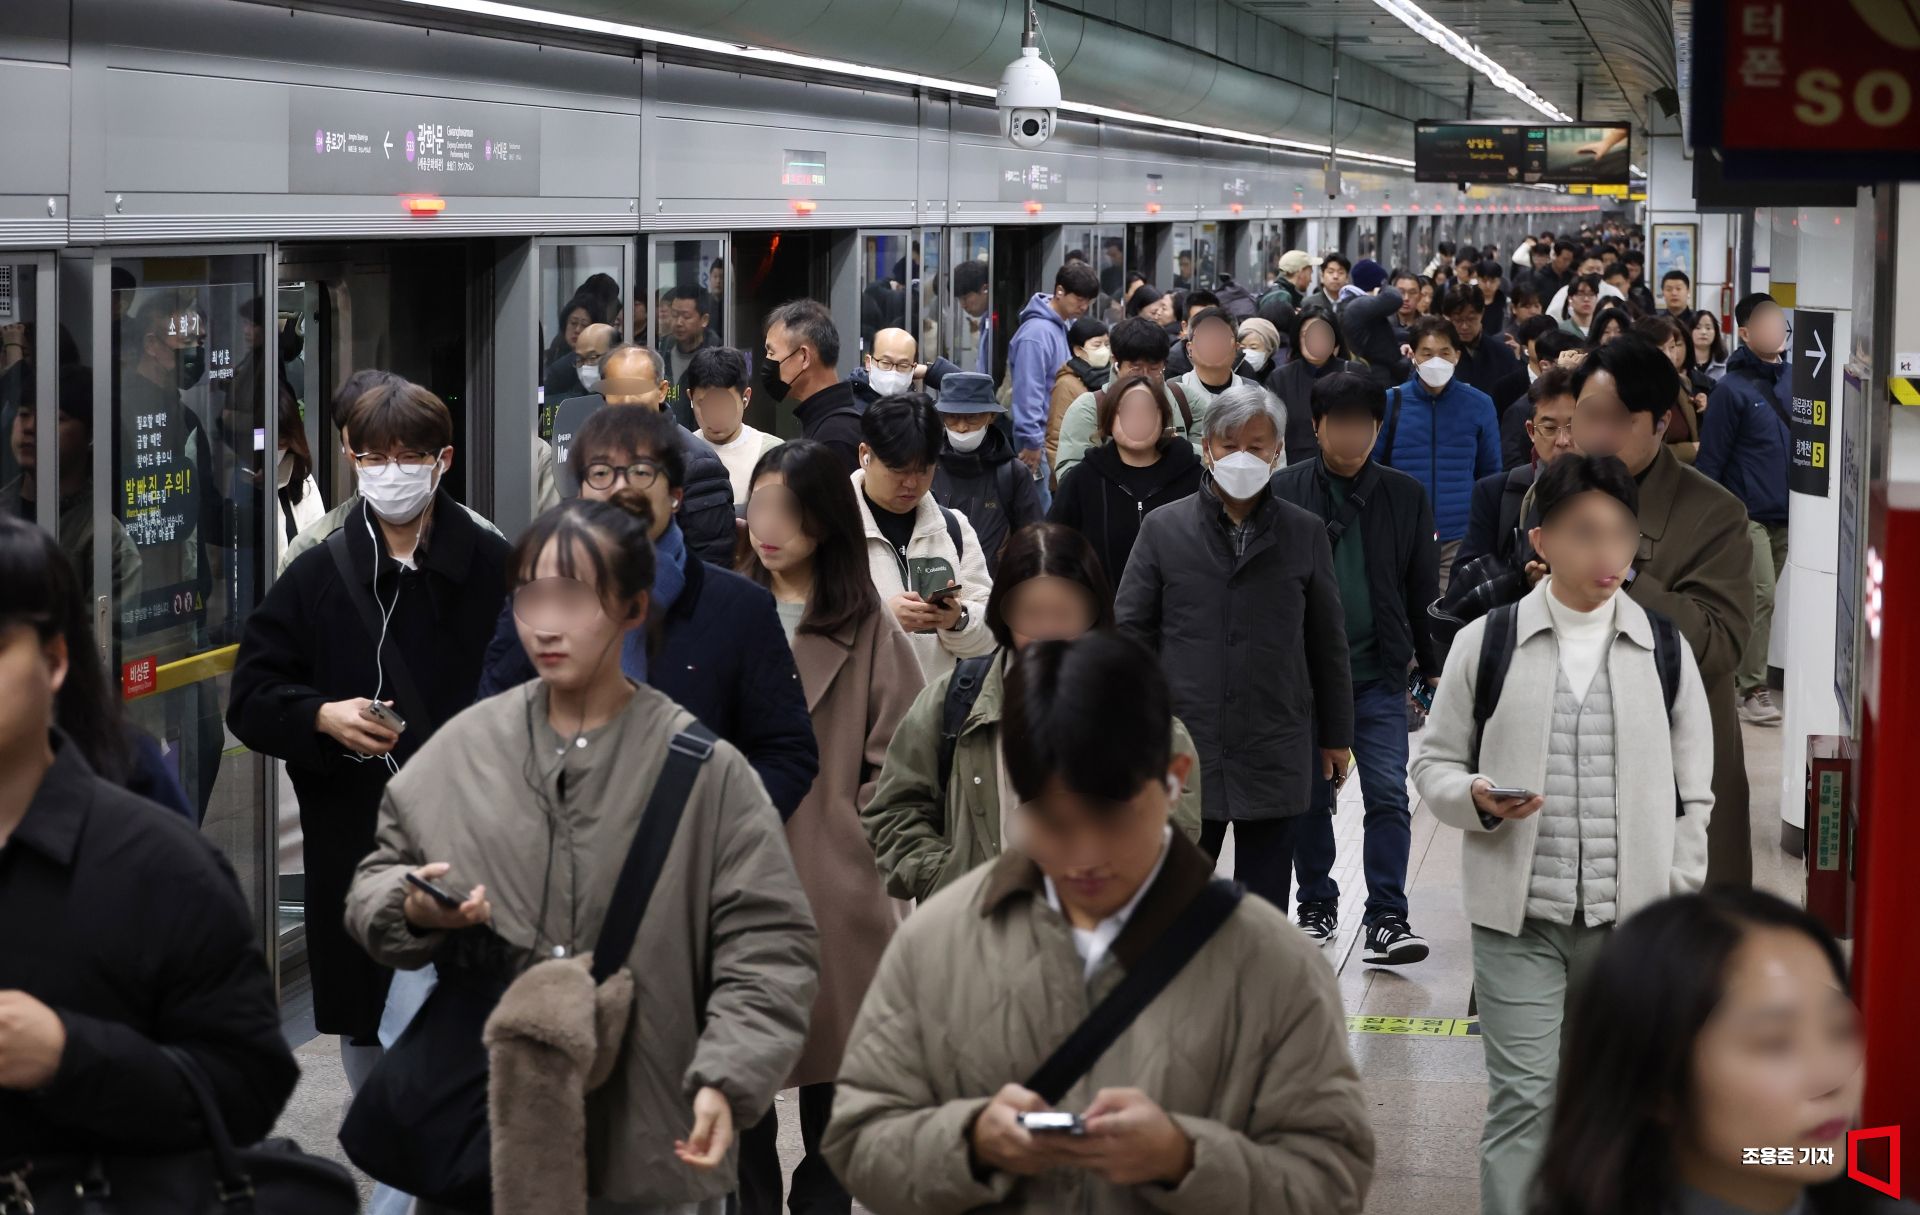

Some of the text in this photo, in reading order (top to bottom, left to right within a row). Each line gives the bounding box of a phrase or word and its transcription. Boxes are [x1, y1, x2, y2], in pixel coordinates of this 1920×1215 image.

[1795, 68, 1911, 127] SO
[326, 131, 346, 153] 종로3가
[417, 123, 444, 155] 광화문
[1901, 362, 1911, 371] kt
[164, 469, 191, 498] 주의!
[130, 661, 149, 682] 비상문
